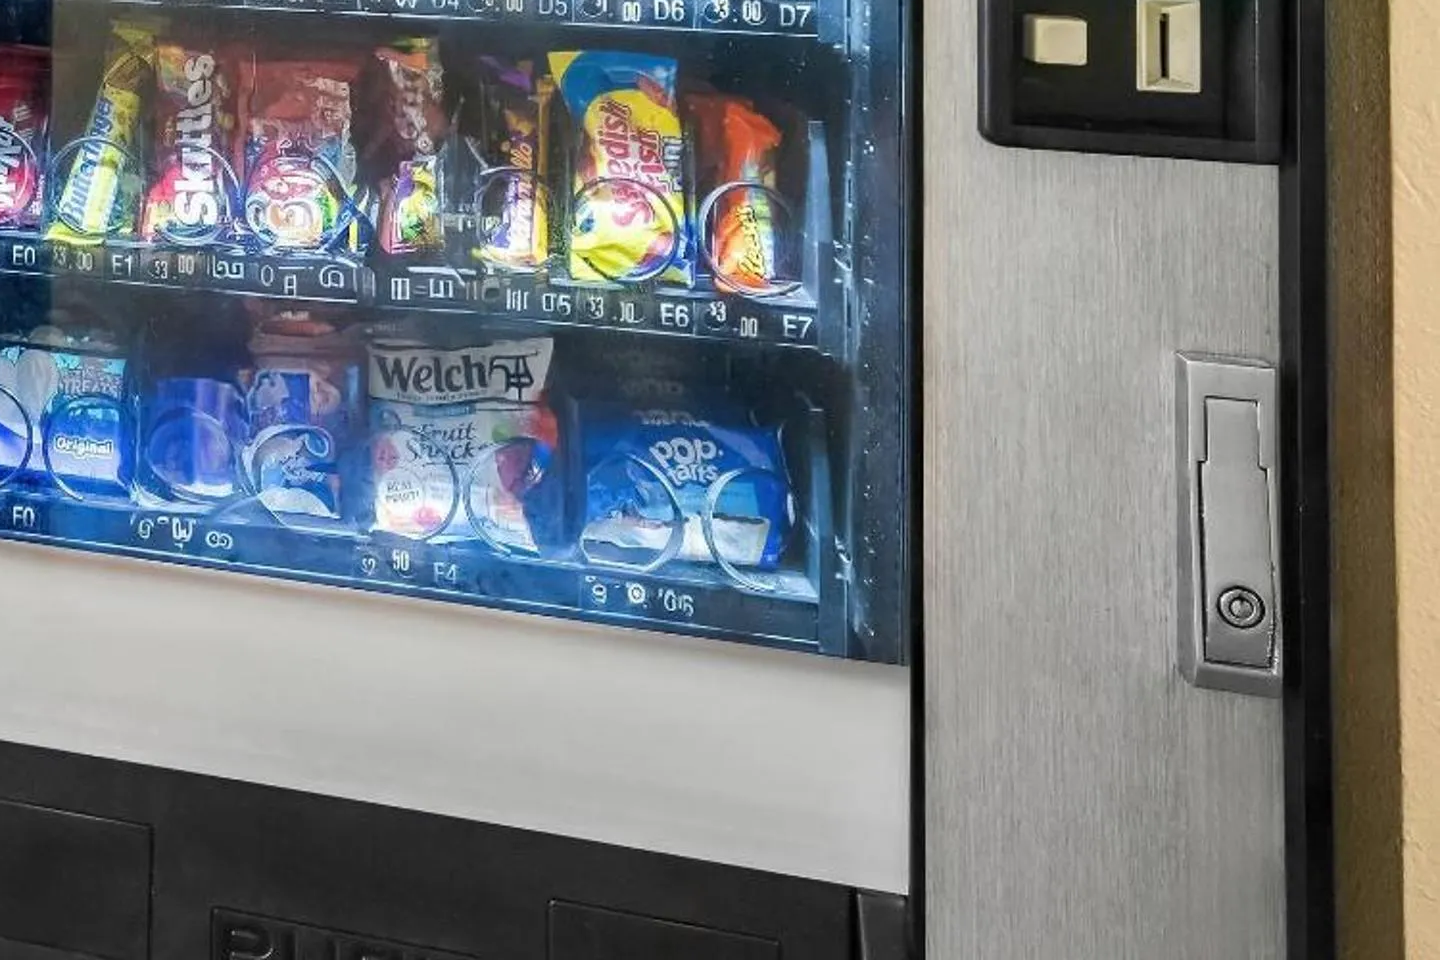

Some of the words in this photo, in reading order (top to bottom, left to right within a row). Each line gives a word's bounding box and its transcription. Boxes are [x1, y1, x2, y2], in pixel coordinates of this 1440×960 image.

[779, 3, 812, 27] D7
[12, 245, 35, 266] E0
[112, 254, 132, 277] E1
[660, 302, 690, 328] E6
[782, 314, 813, 339] E7
[54, 435, 113, 458] Original
[433, 562, 457, 585] F4
